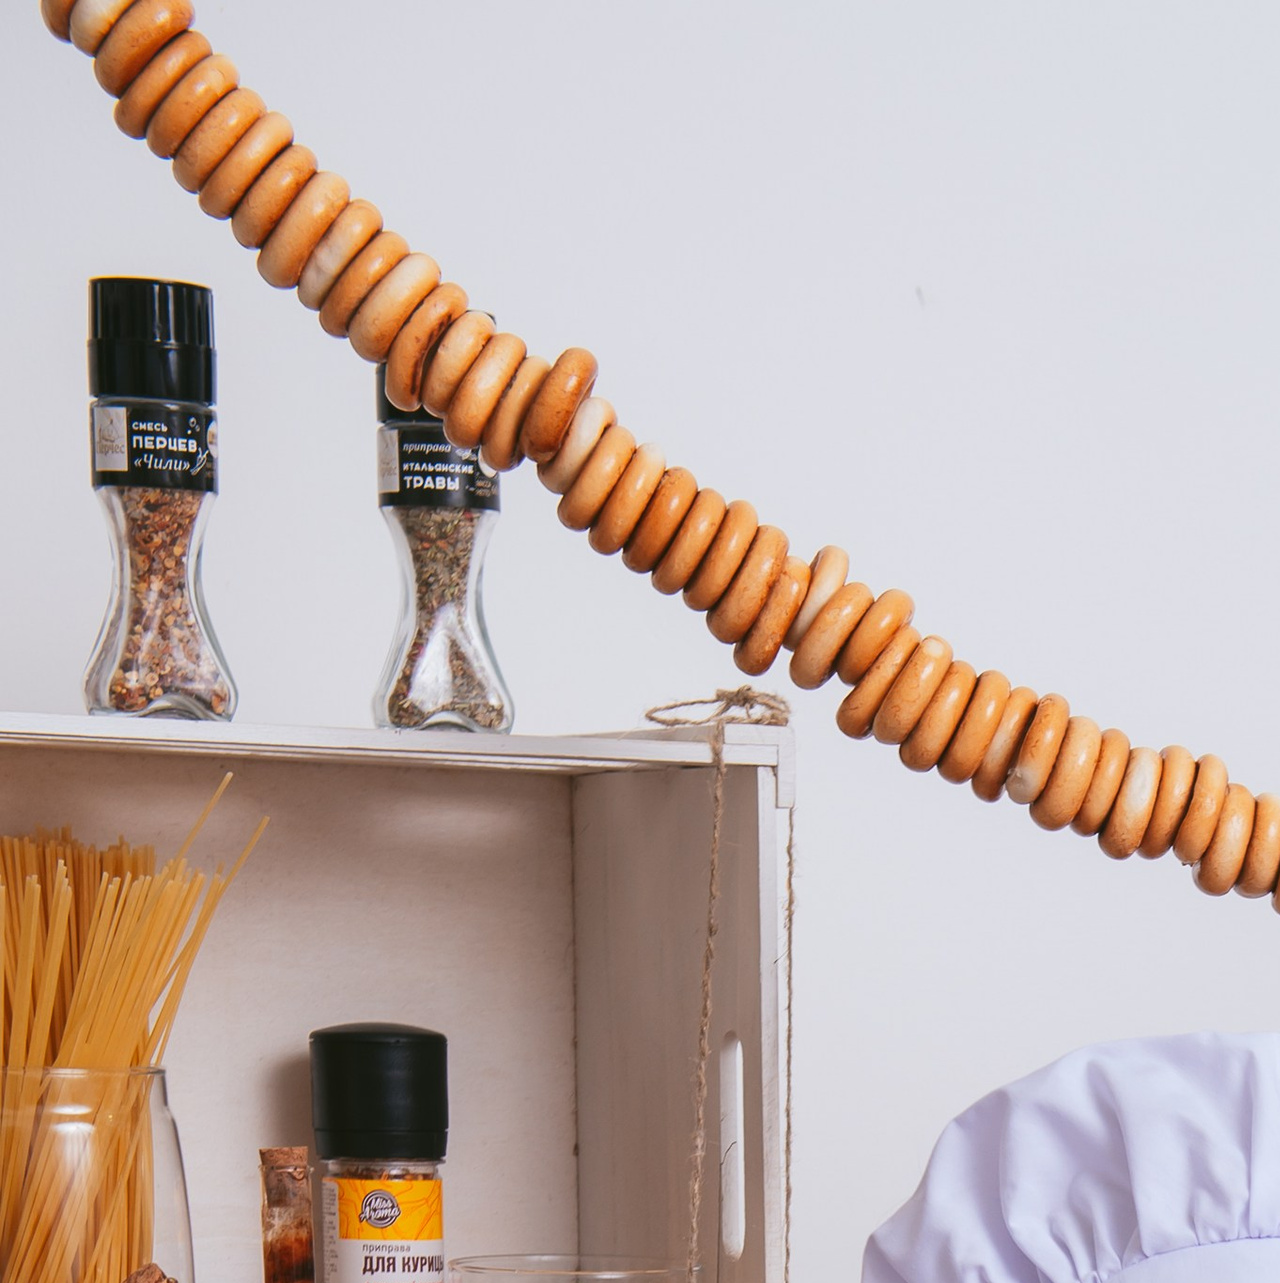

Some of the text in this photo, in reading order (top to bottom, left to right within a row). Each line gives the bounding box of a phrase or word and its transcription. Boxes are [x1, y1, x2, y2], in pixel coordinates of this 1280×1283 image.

[132, 421, 168, 433] СМЕСЬ
[132, 435, 198, 453] ПЕРЦЕВ
[402, 443, 452, 455] приправа
[134, 453, 191, 471] «Чили»
[403, 475, 460, 491] ТРАВЫ
[362, 1244, 411, 1253] приправа
[362, 1255, 396, 1275] ДЛЯ
